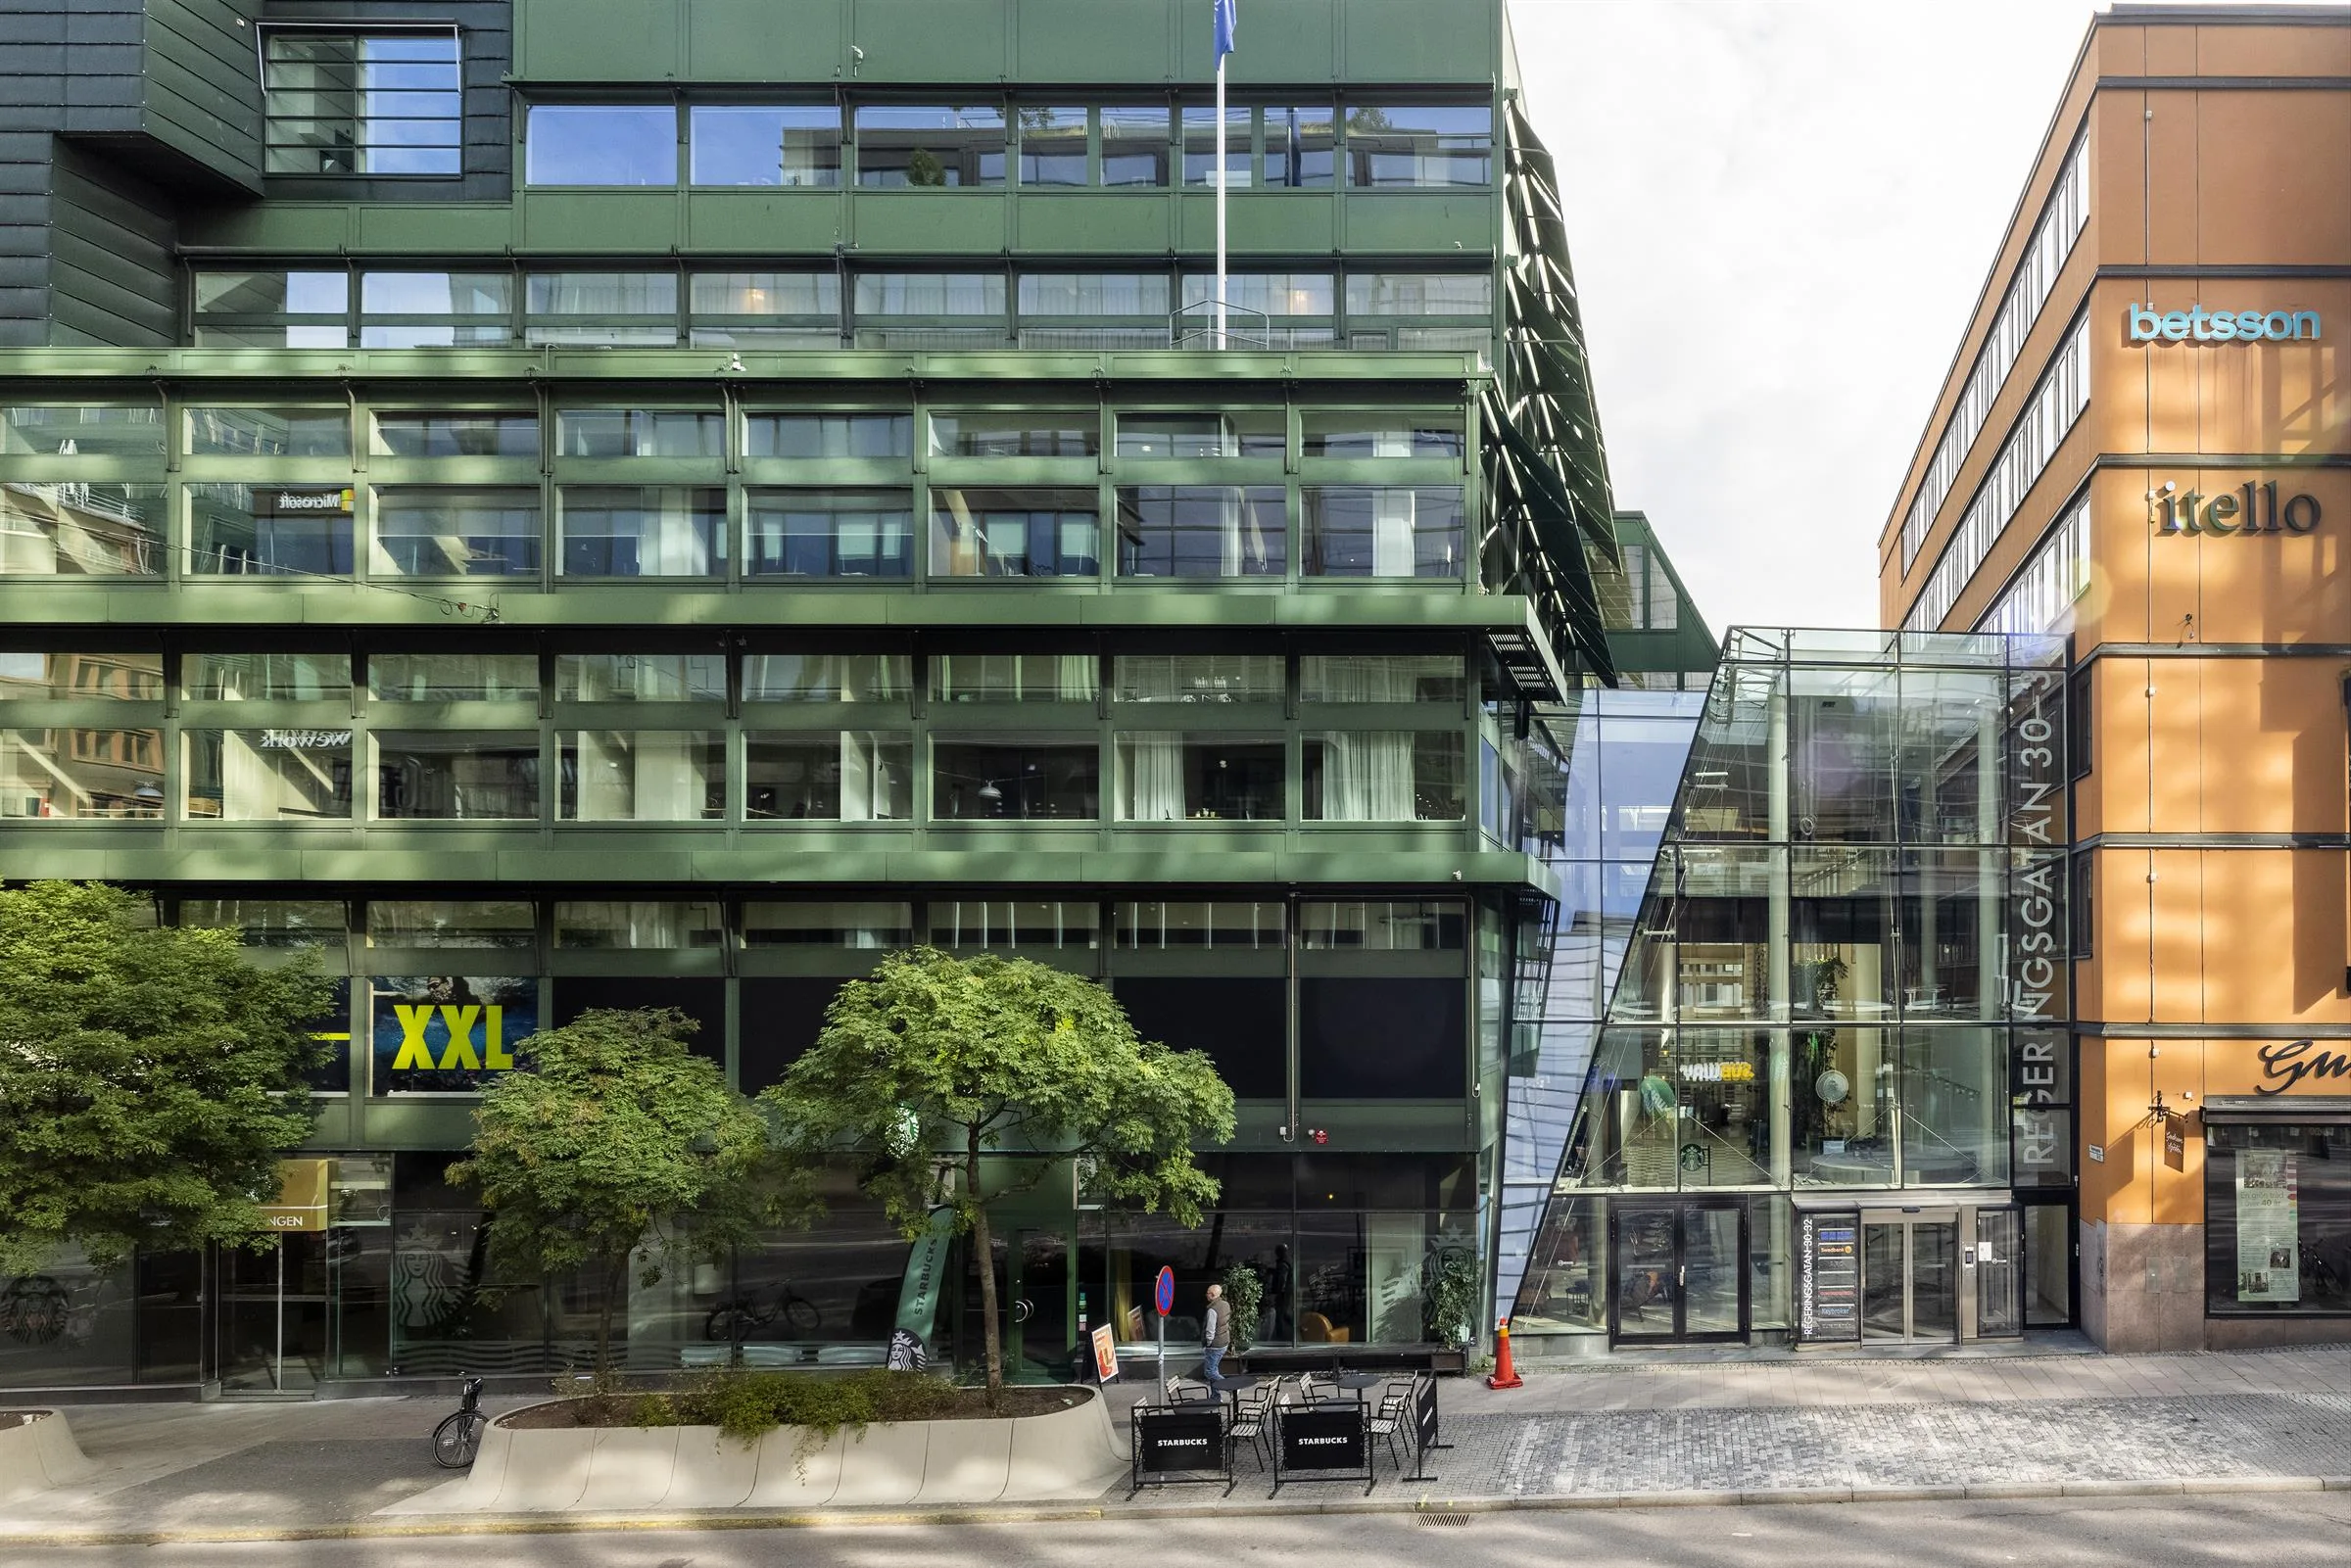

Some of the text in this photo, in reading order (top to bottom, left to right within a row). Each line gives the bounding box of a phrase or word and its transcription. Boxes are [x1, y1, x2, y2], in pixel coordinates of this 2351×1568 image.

[2131, 303, 2321, 341] betsson
[2162, 480, 2322, 532] itello
[392, 1005, 513, 1069] XXL
[914, 1238, 937, 1316] STARBUCKS
[1803, 1250, 1813, 1334] REGERINGSGATAN
[1157, 1438, 1208, 1447] STARBUCKS
[1298, 1437, 1348, 1446] STARBUCKS
